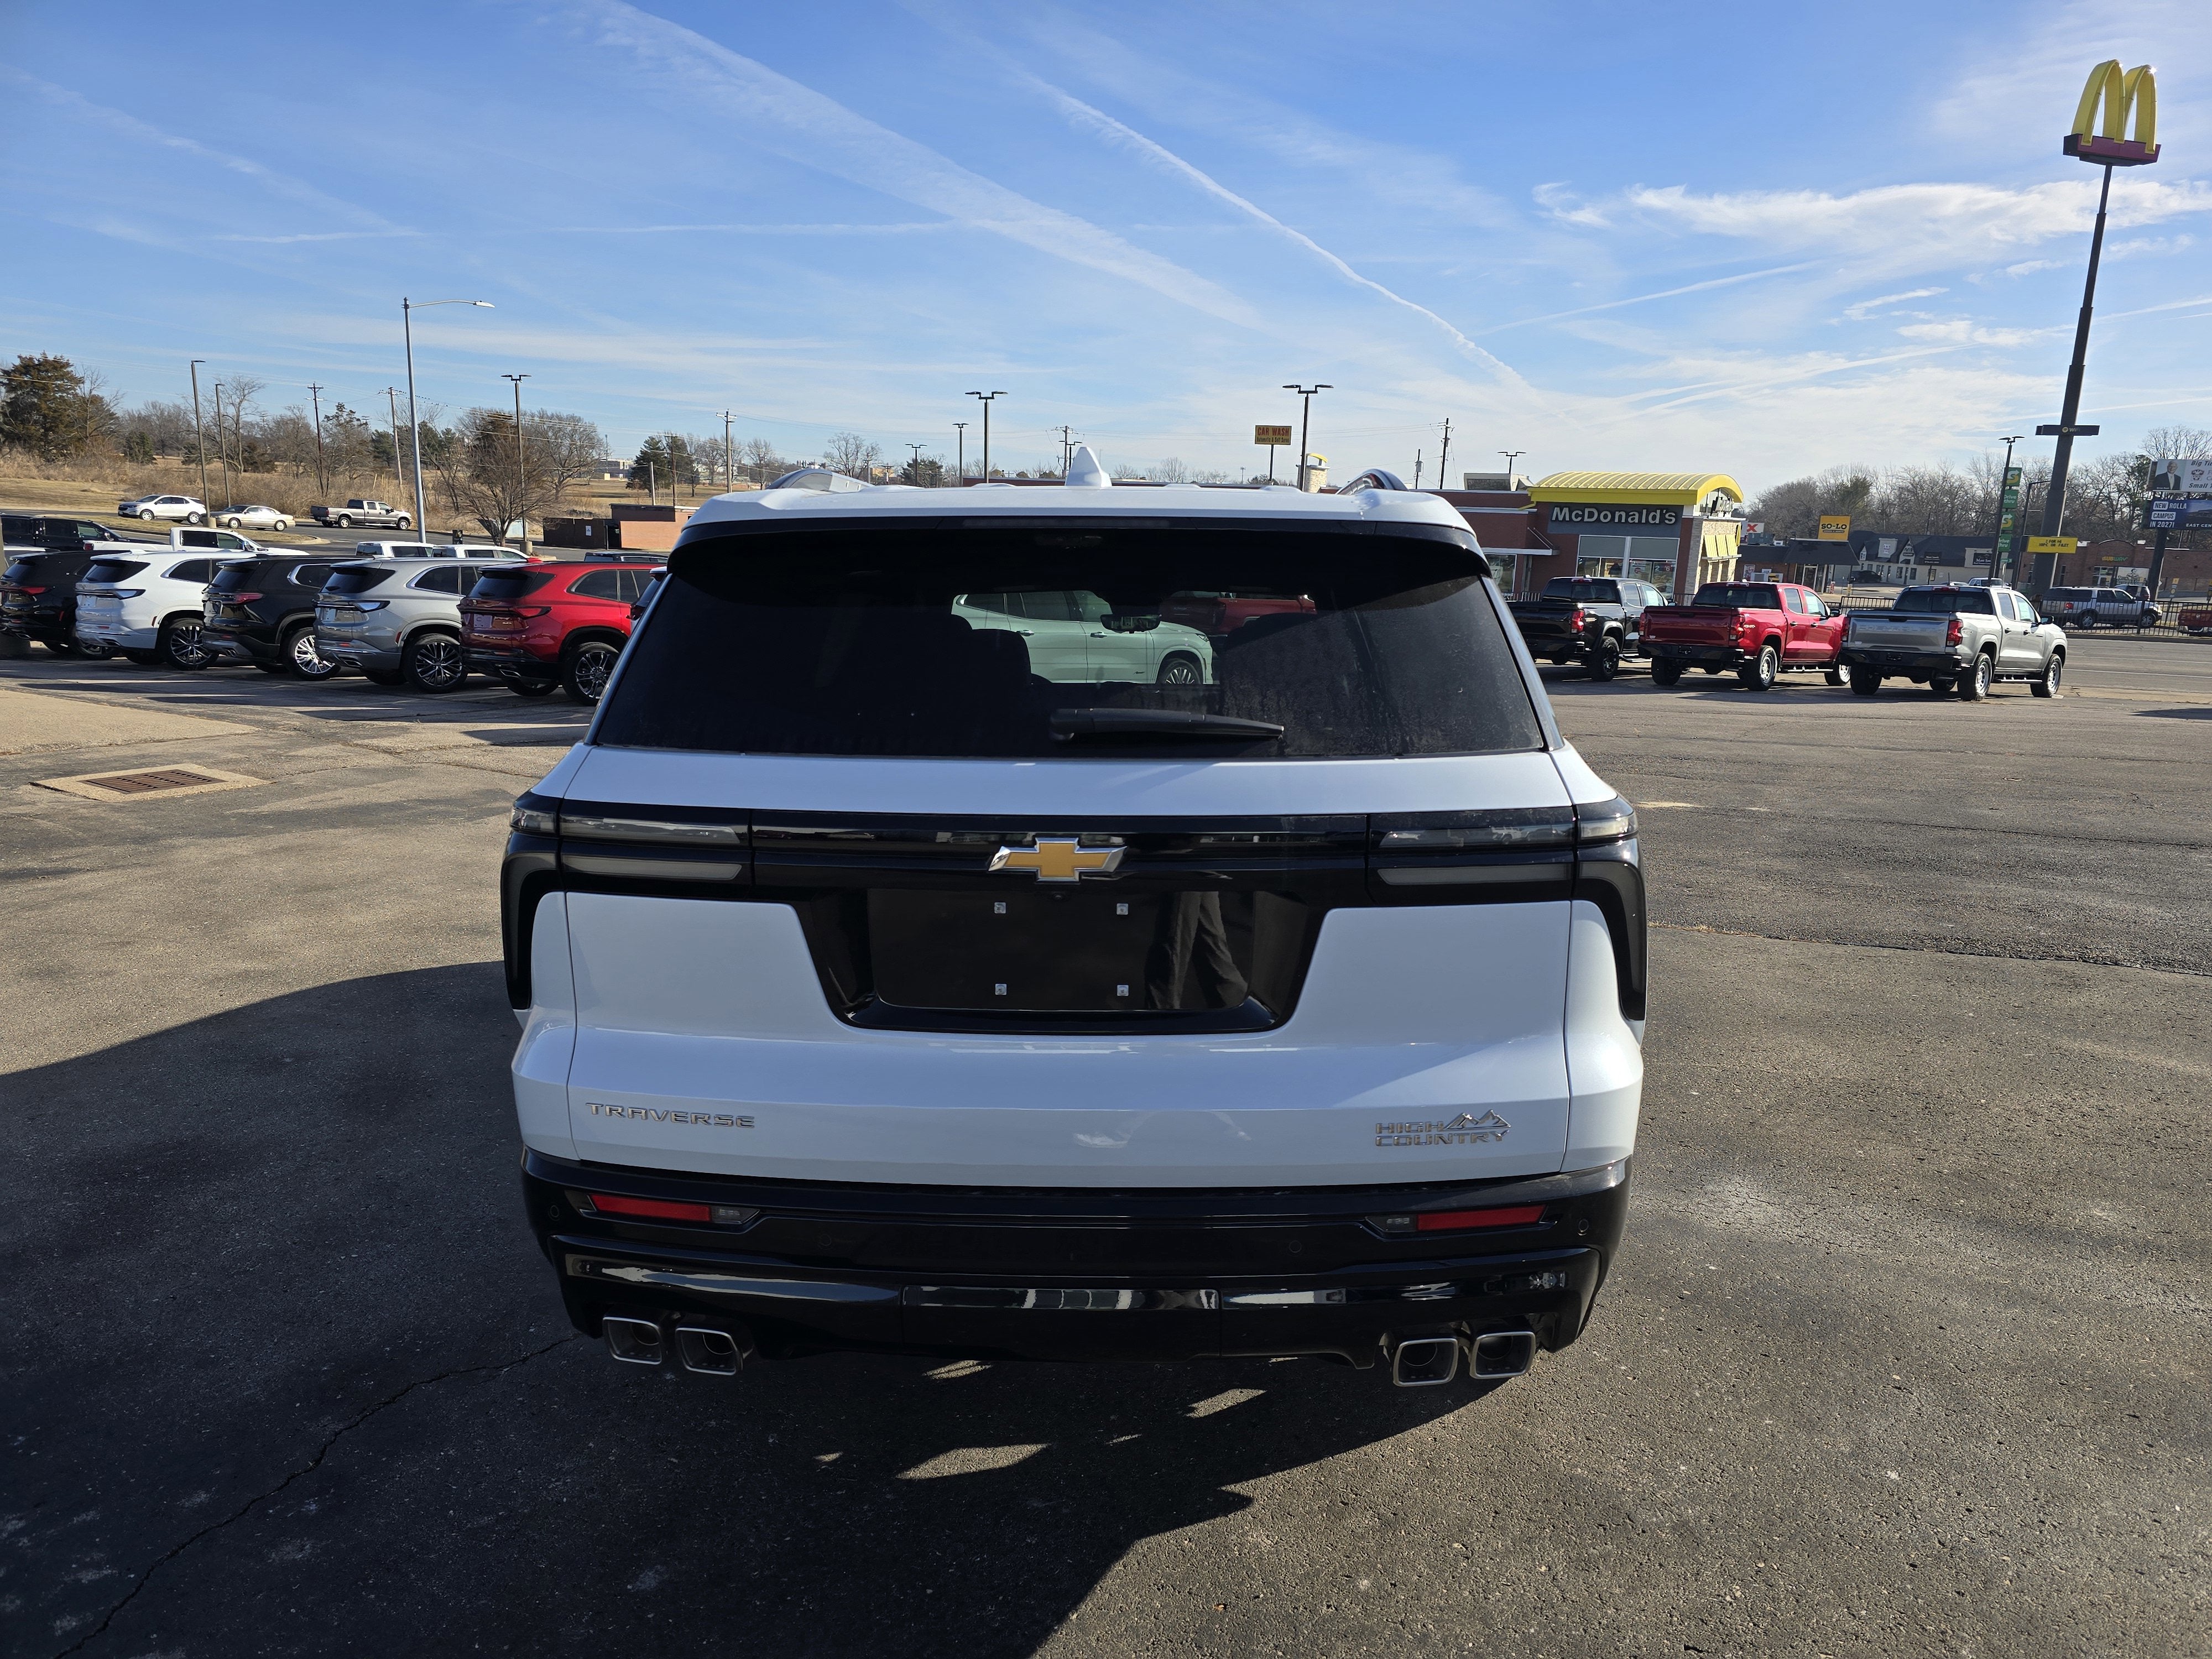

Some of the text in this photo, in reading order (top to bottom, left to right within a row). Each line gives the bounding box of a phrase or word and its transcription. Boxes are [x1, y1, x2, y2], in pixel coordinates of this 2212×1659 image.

[1258, 427, 1289, 436] CAR WASH
[1552, 507, 1676, 524] McDonald's
[586, 1103, 755, 1128] TRAVERSE
[1375, 1120, 1444, 1134] HIGH
[1375, 1129, 1510, 1146] COUNTRY
